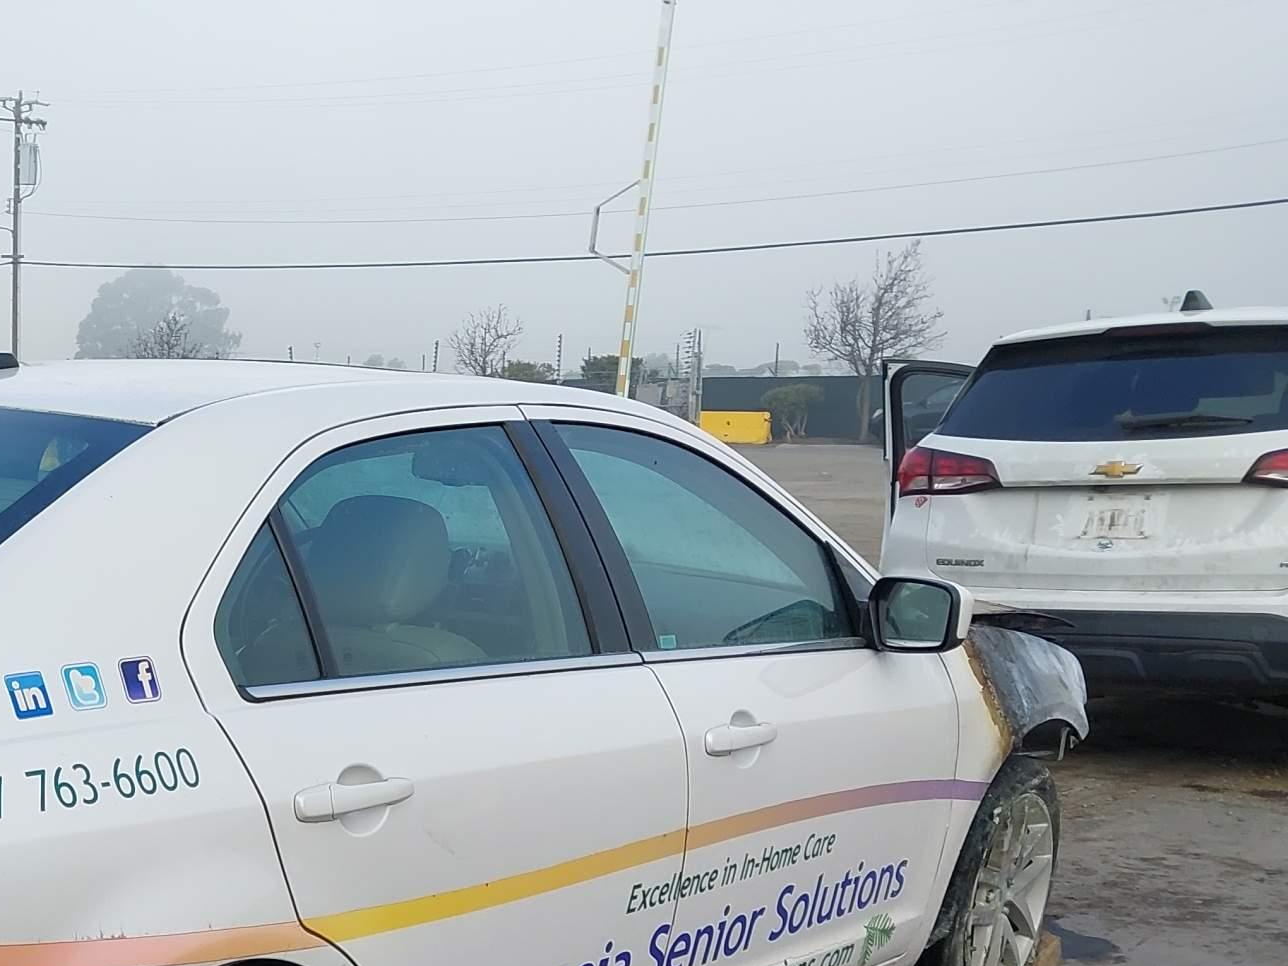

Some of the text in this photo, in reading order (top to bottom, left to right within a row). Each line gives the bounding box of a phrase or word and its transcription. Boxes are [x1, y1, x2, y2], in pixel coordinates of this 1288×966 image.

[12, 681, 48, 712] in
[136, 661, 154, 699] f
[24, 748, 200, 812] 763-6600
[626, 831, 836, 915] Excellence in In-Home Care
[769, 857, 909, 944] Solutions
